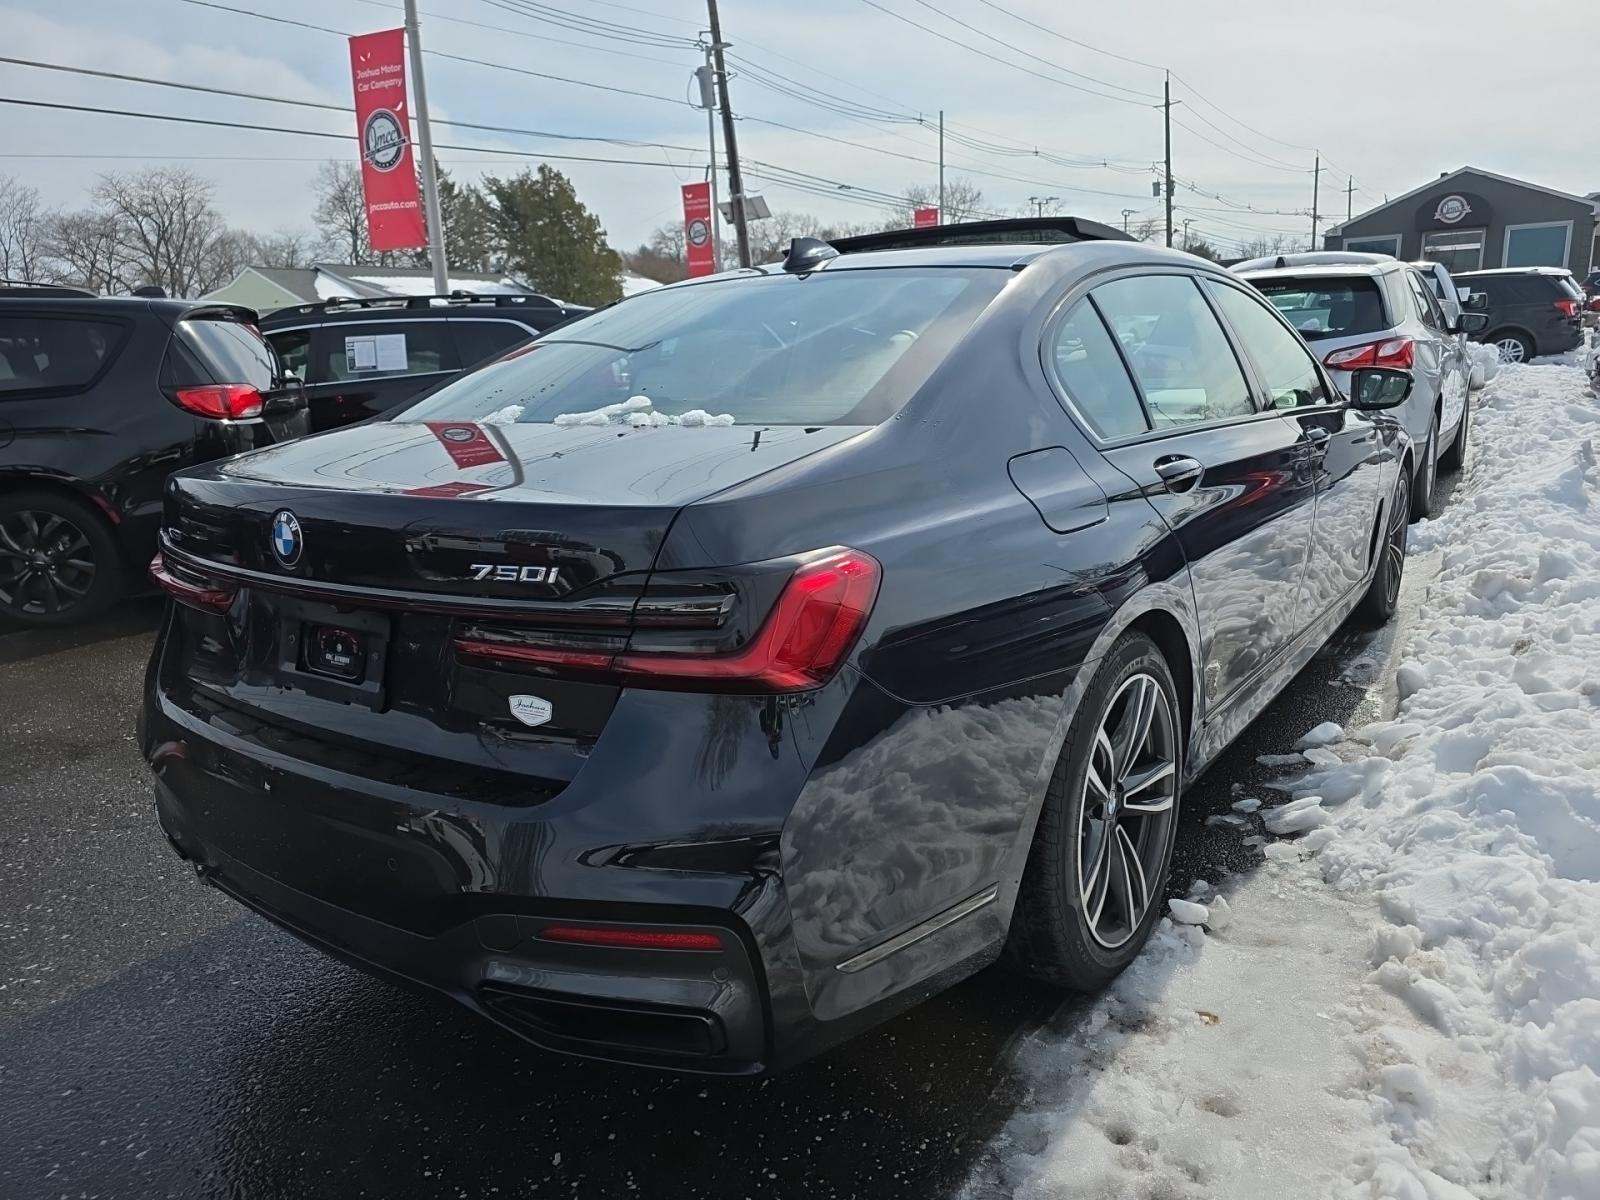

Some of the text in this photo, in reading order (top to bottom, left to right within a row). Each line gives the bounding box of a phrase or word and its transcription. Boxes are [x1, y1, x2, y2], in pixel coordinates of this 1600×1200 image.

[356, 64, 402, 79] Joshua Motor
[357, 78, 402, 92] Car Company
